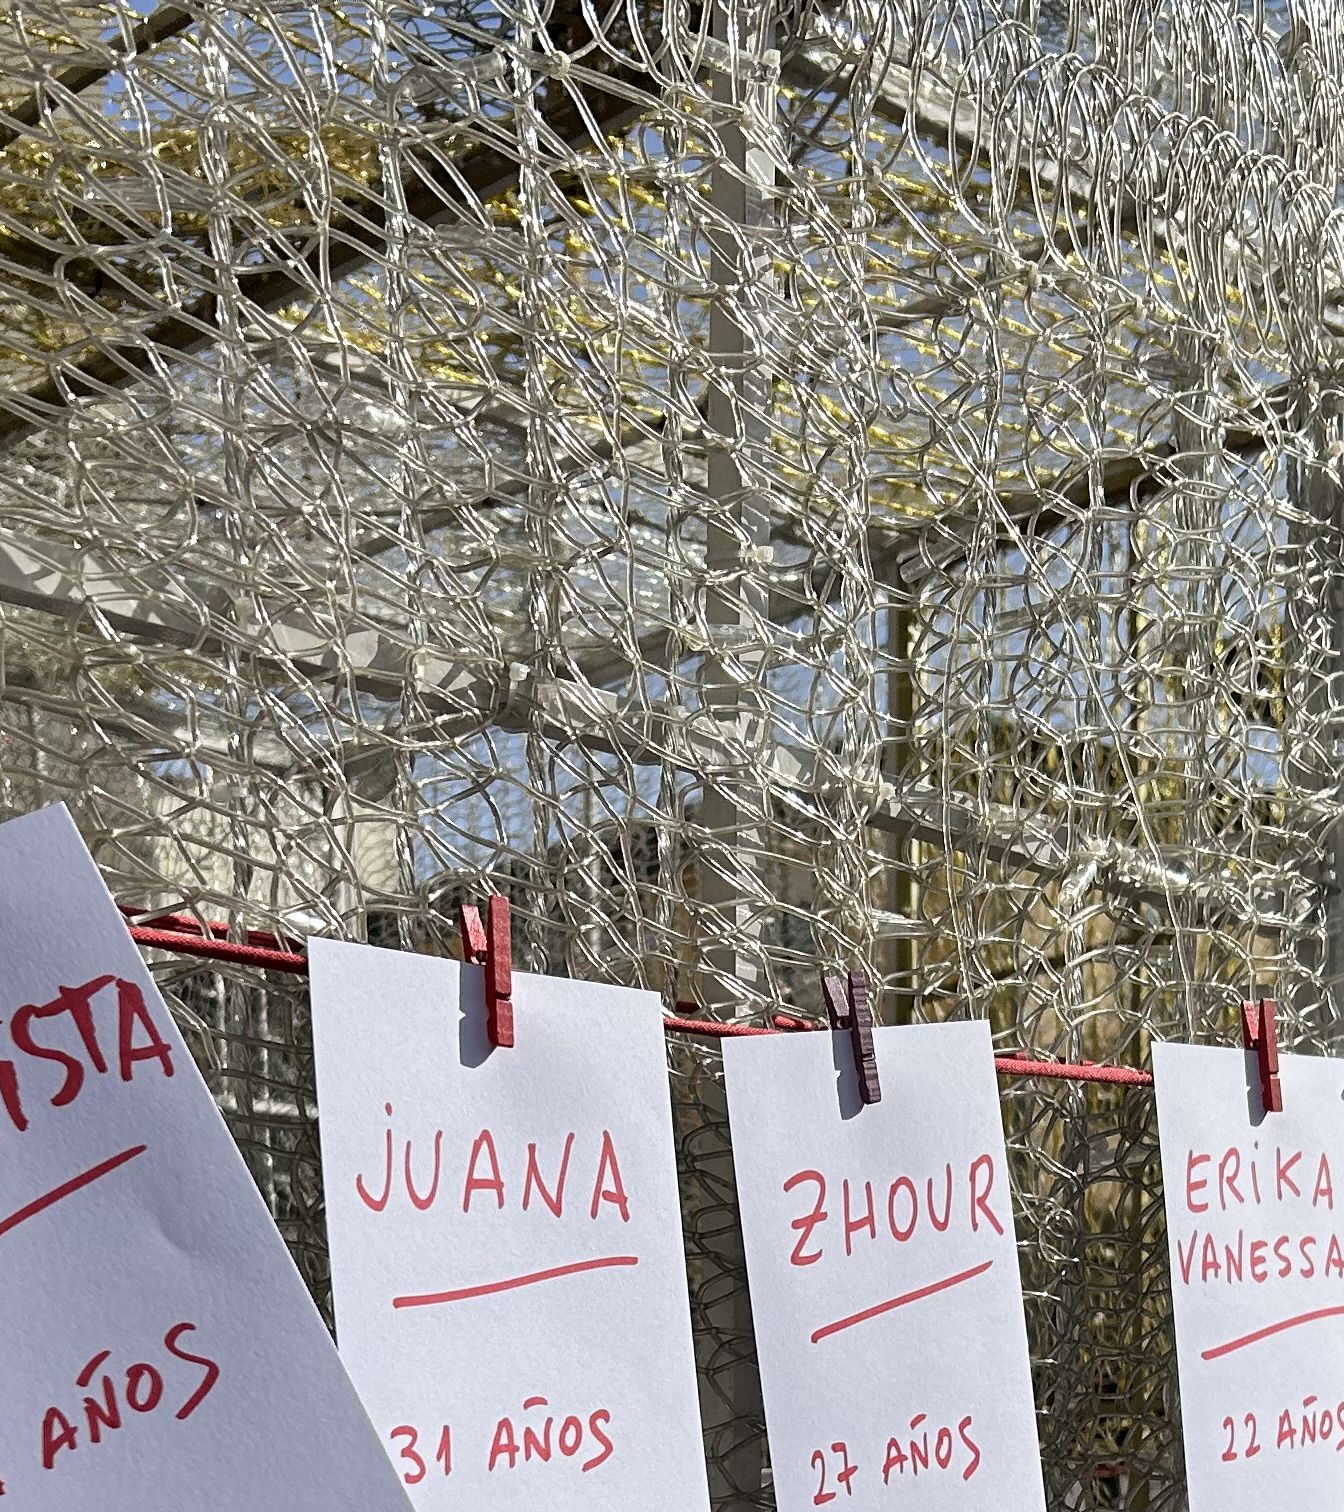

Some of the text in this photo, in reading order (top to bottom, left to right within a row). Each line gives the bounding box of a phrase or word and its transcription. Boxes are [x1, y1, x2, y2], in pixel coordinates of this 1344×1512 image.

[782, 1152, 1006, 1267] ZHOUR
[42, 1322, 220, 1470] AÑOS
[389, 1395, 615, 1486] 31 AÑOS
[1221, 1412, 1262, 1462] 22
[811, 1412, 983, 1506] 27 AÑOS
